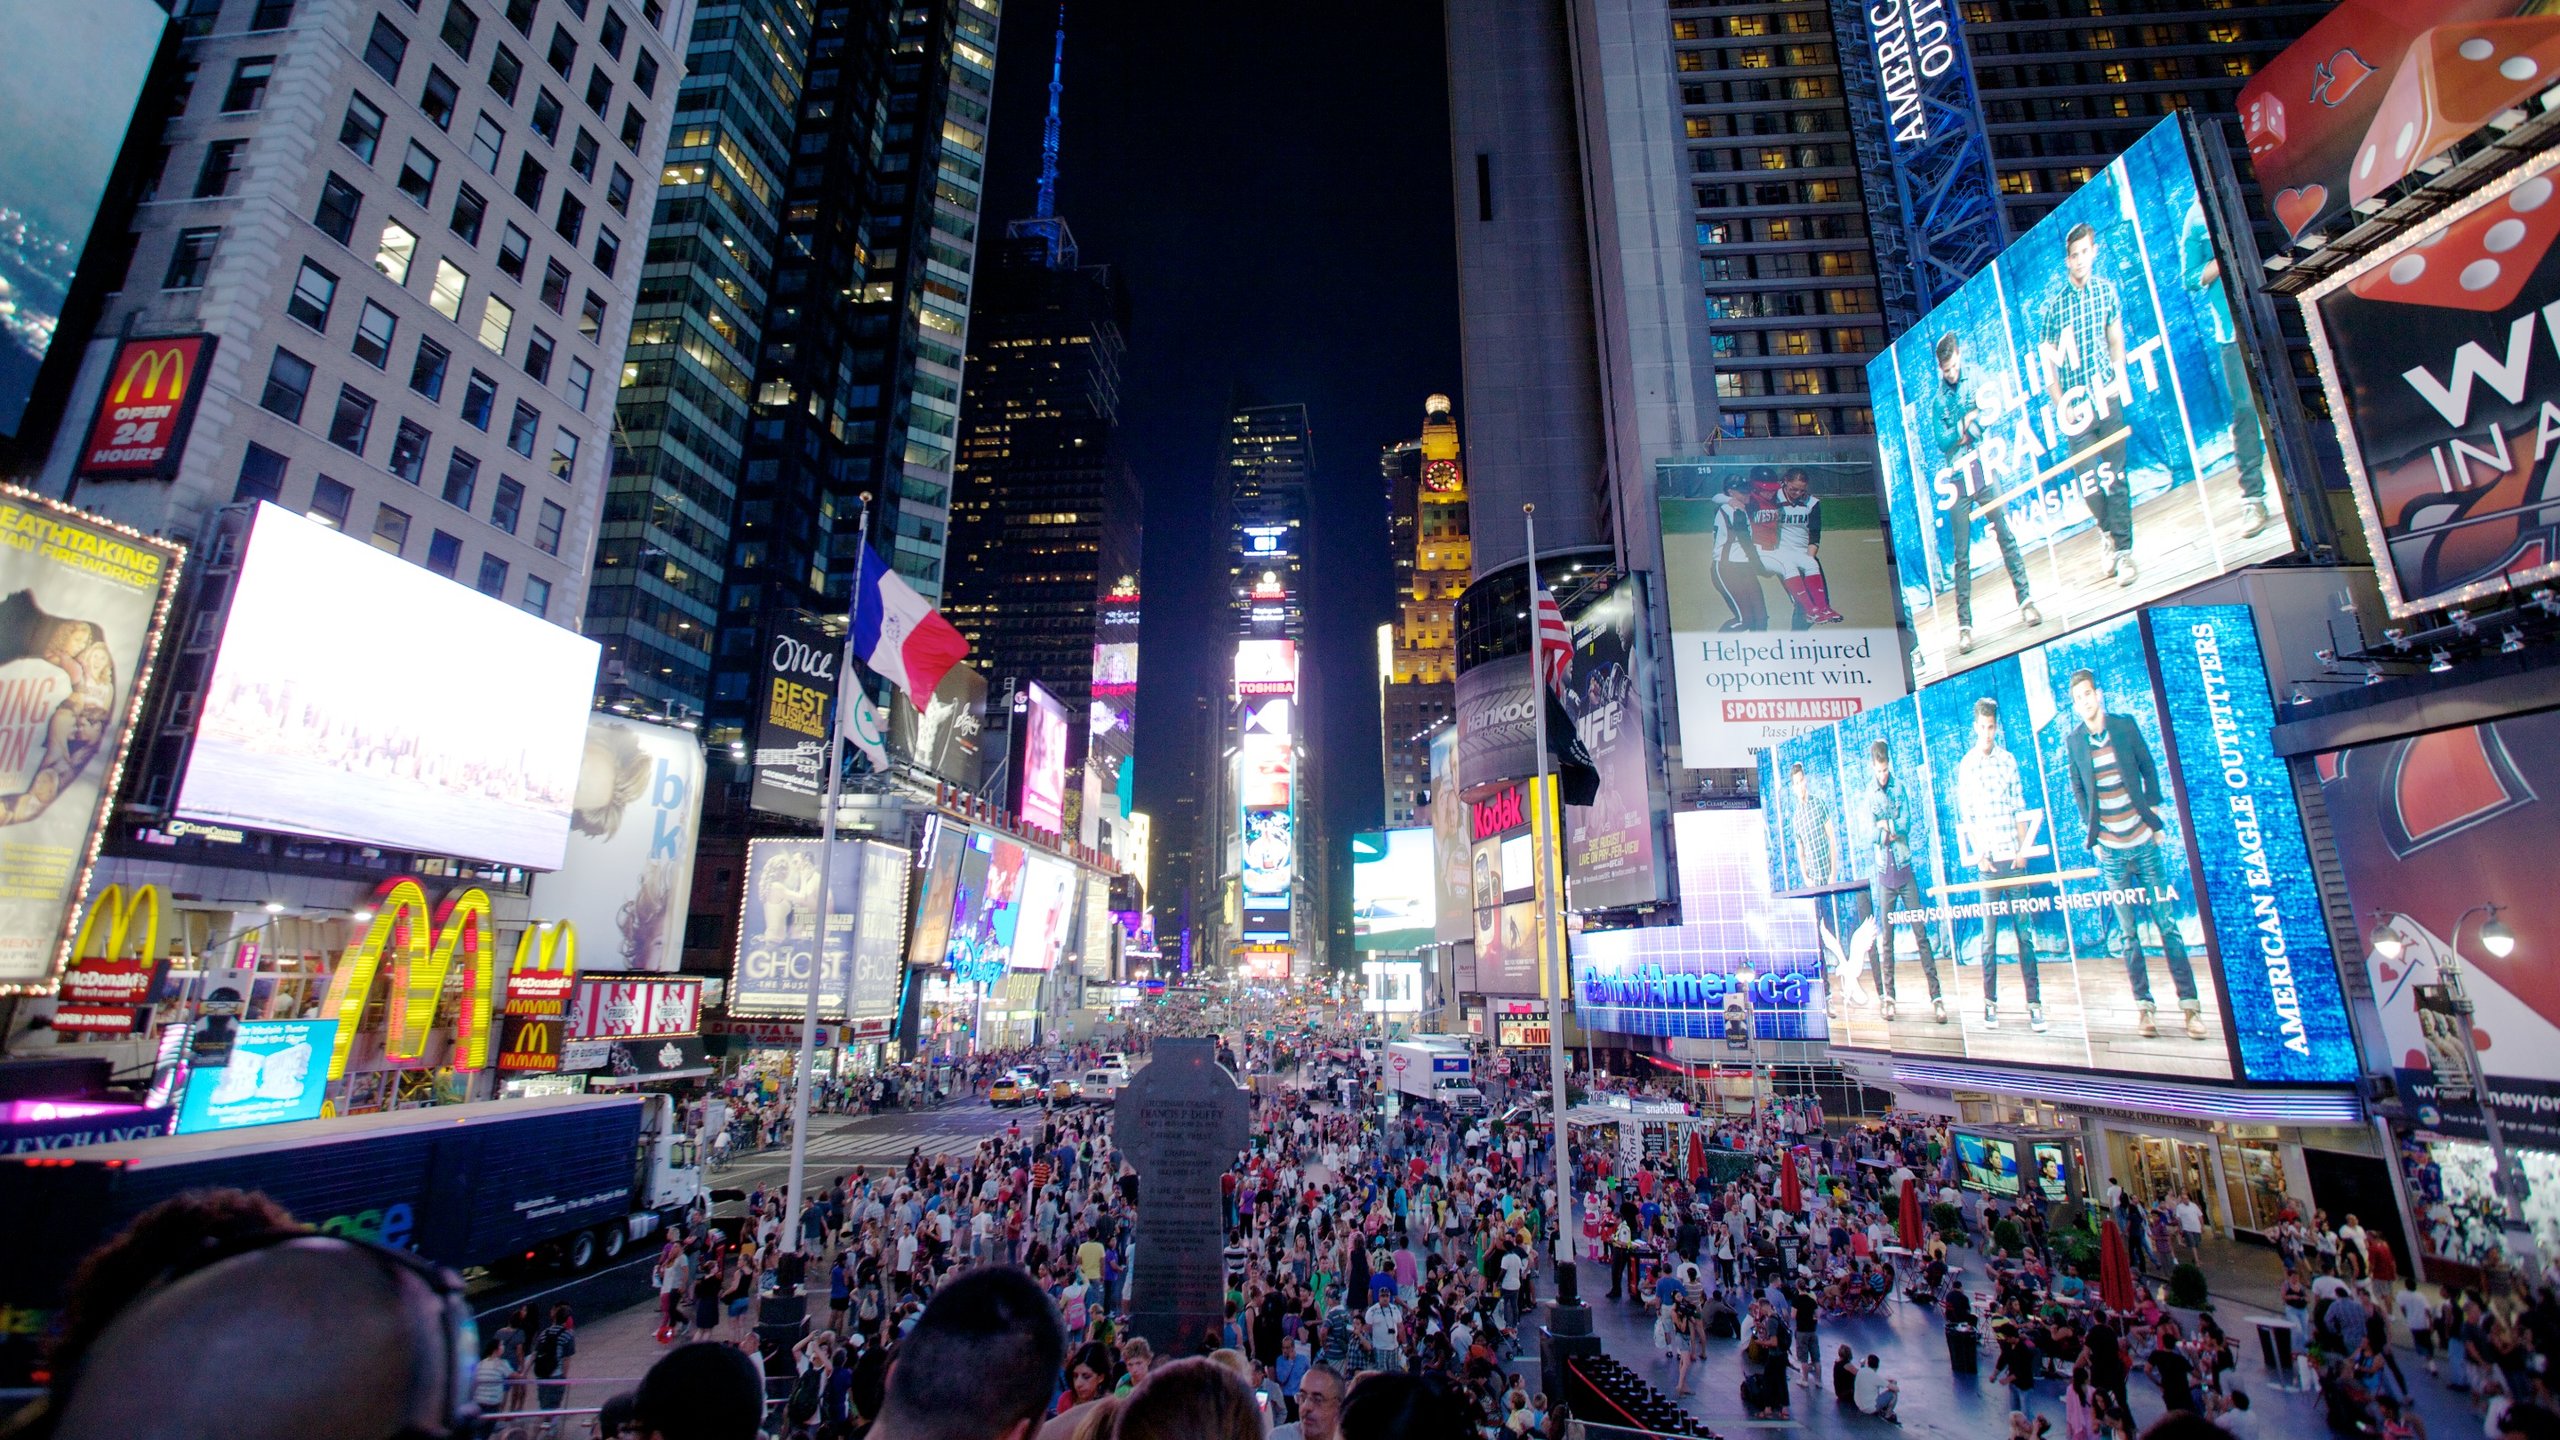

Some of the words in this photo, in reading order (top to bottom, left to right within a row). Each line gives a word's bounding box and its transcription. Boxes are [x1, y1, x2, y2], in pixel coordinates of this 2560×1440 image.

[1975, 326, 2080, 427] SLIM
[114, 405, 172, 421] OPEN
[1934, 335, 2161, 510] STRAIGHT
[111, 421, 159, 445] 24
[92, 447, 166, 463] HOURS
[2431, 422, 2512, 493] IN
[2005, 461, 2126, 531] WASHES.
[1702, 639, 1783, 667] Helped
[1790, 637, 1870, 665] injured
[1240, 682, 1293, 693] TOSHIBA
[1706, 669, 1821, 692] opponent
[1822, 664, 1872, 685] win.
[772, 677, 828, 715] BEST
[1726, 699, 1858, 719] SPORTSMANSHIP
[2192, 622, 2248, 790] OUTFITTERS
[771, 701, 824, 729] MUSICAL
[1467, 700, 1535, 733] Hankoo
[1576, 701, 1618, 751] UFC
[1762, 725, 1787, 737] Pass
[1791, 725, 1800, 736] It
[1473, 785, 1523, 839] Kodak
[1956, 808, 2050, 867] DEZ
[2229, 794, 2273, 889] EAGLE
[1887, 900, 2009, 925] SINGER/SONGWRITER
[2012, 896, 2051, 914] FROM
[2054, 886, 2151, 910] SHREVPORT,
[2155, 884, 2179, 904] LA
[64, 971, 149, 990] McDonald's
[509, 977, 572, 989] McDonald's
[1585, 965, 1625, 1001] Bank
[1630, 964, 1647, 1002] of
[1647, 962, 1811, 1004] America
[2251, 894, 2309, 1056] AMERICAN
[73, 986, 131, 998] Restaurant
[517, 988, 560, 996] Restaurant
[54, 1013, 80, 1024] OPEN
[98, 1014, 132, 1026] HOURS
[608, 1008, 634, 1018] FRIDAYS
[660, 1007, 683, 1018] FRIDAYS
[712, 1023, 794, 1035] DIGITAL
[1646, 1102, 1685, 1114] snackBOX
[2061, 1103, 2105, 1115] AMERICAN
[2107, 1108, 2134, 1119] EAGLE
[2137, 1112, 2197, 1127] OUTFITTERS
[14, 1124, 162, 1153] EXCHANGE
